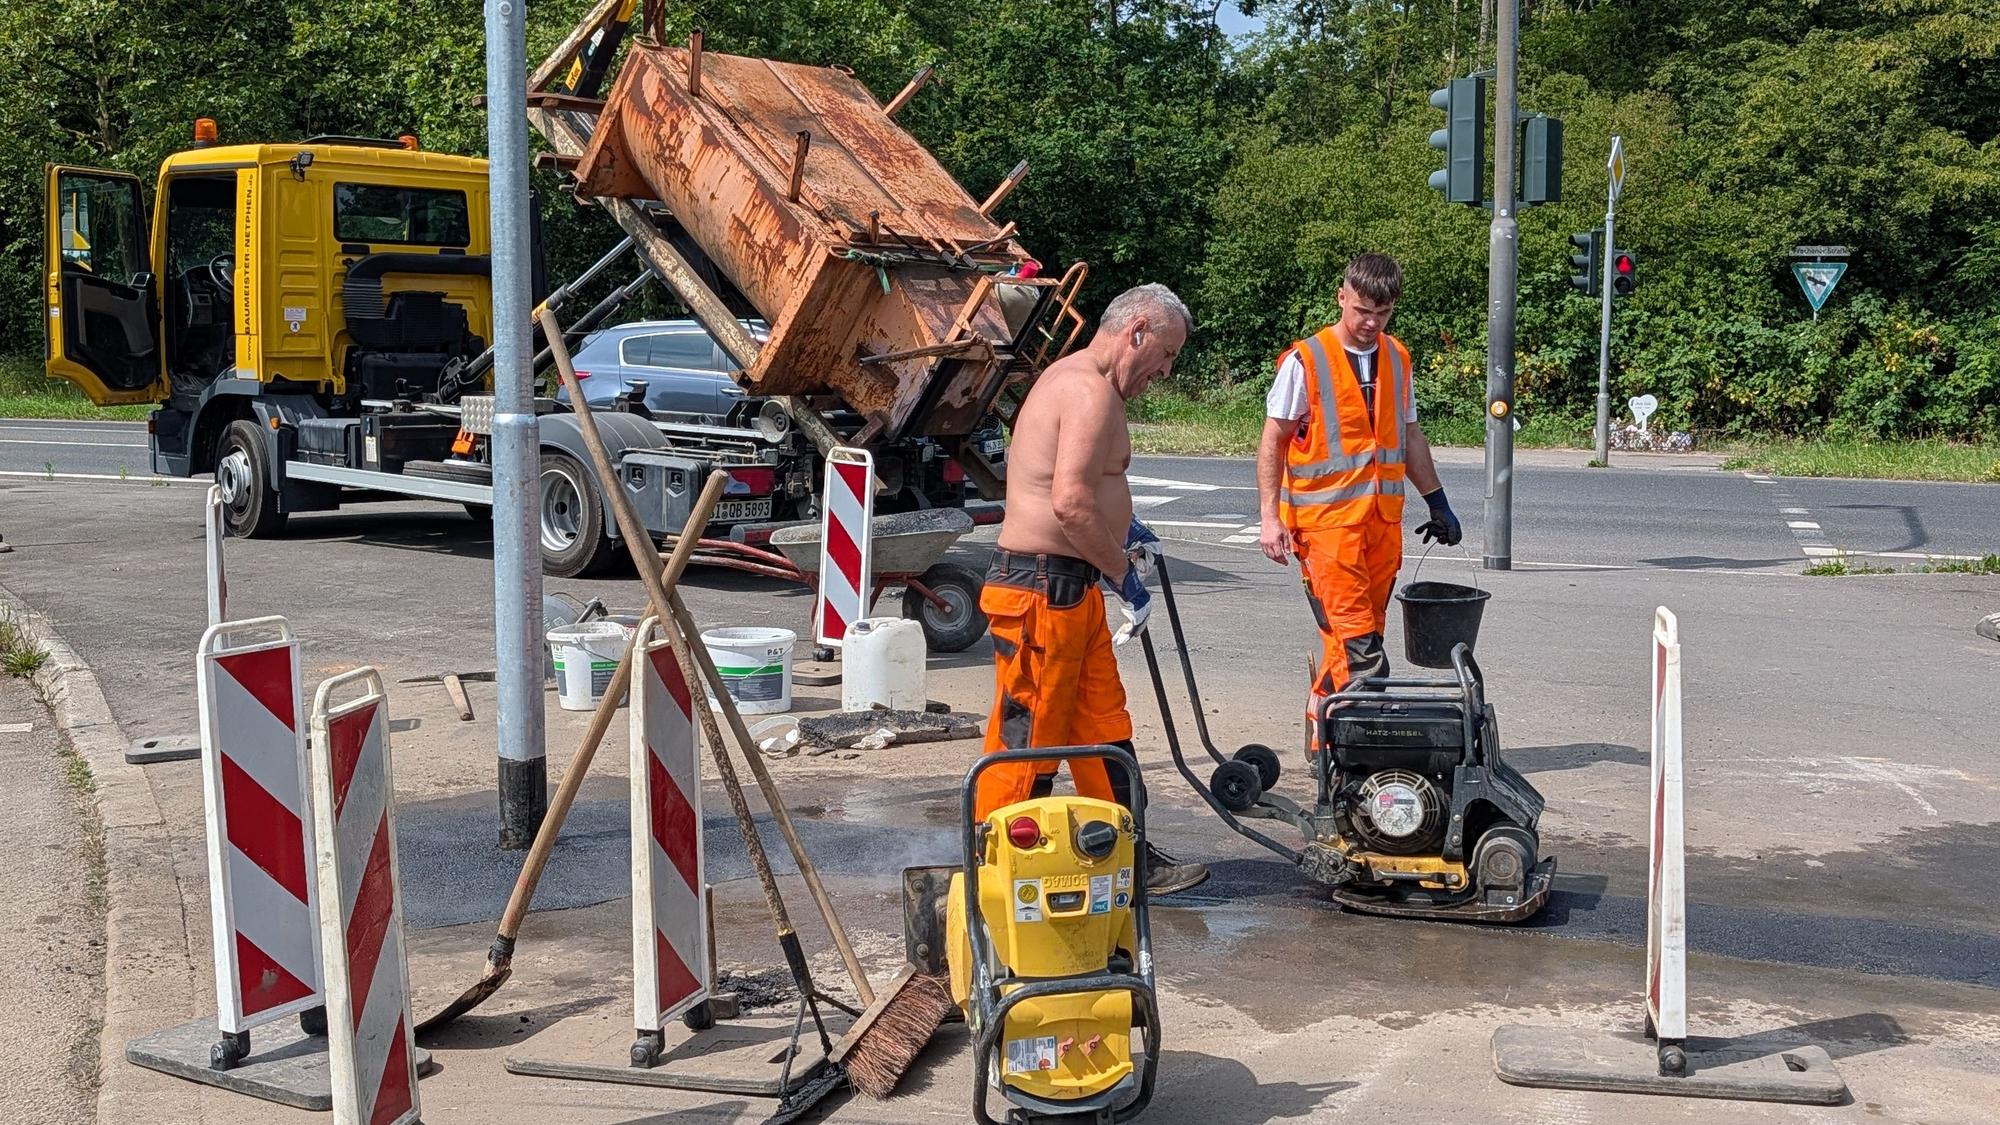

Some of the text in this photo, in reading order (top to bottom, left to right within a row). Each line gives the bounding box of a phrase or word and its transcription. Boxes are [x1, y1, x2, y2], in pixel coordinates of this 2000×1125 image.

[729, 503, 742, 518] QB
[745, 501, 770, 517] 5893
[1042, 873, 1089, 889] BOMAG
